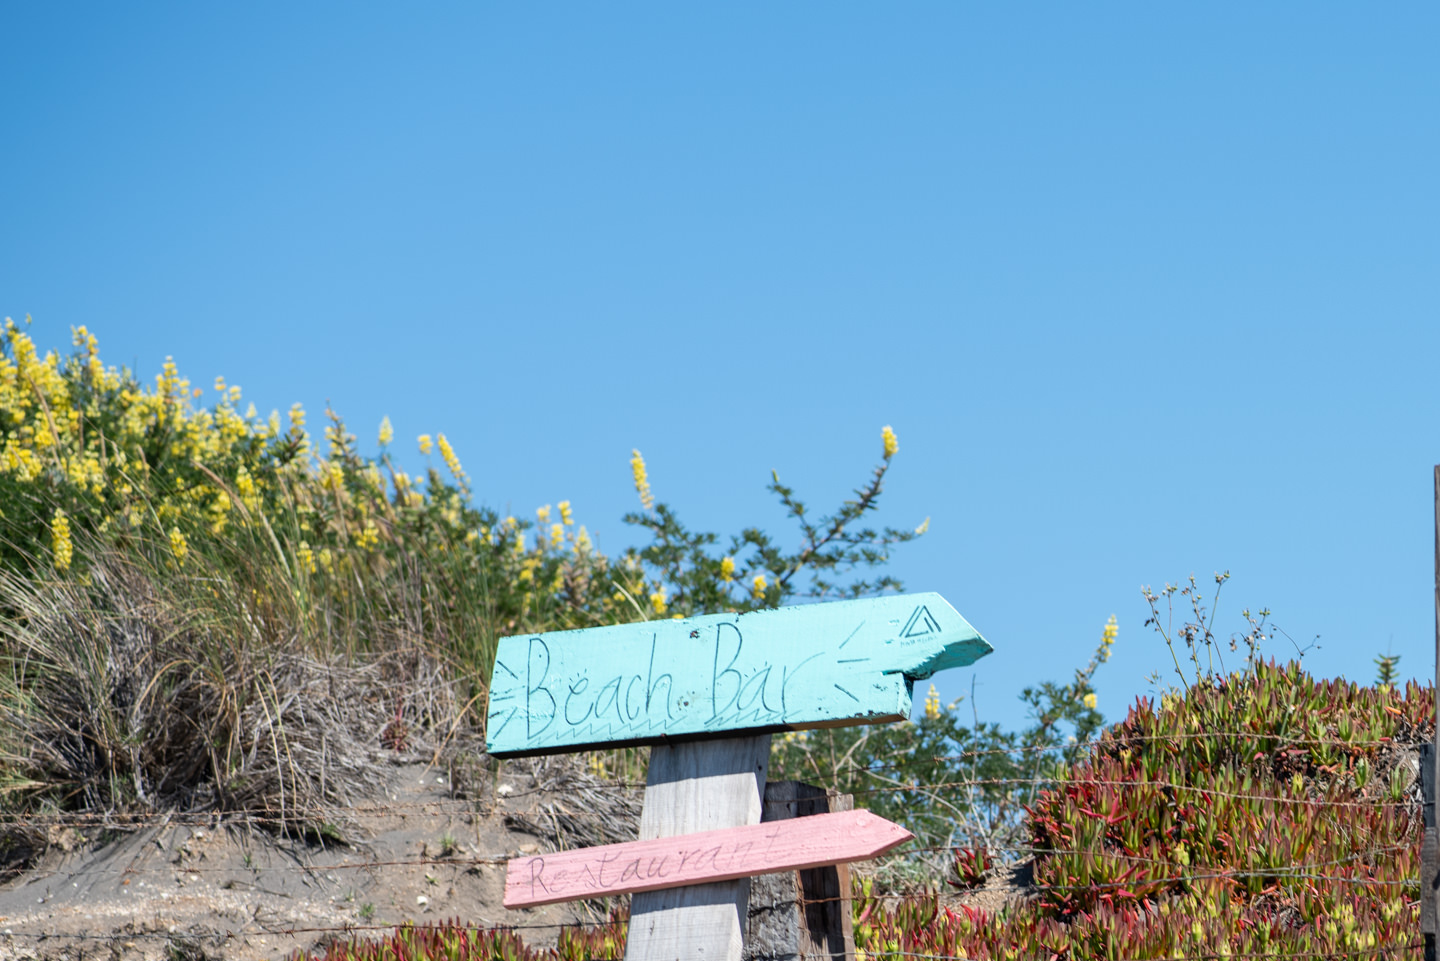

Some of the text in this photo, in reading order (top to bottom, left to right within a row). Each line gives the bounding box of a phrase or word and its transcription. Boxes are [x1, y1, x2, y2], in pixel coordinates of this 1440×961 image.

[527, 622, 826, 741] Beach Bar
[526, 825, 792, 898] Restaurant
